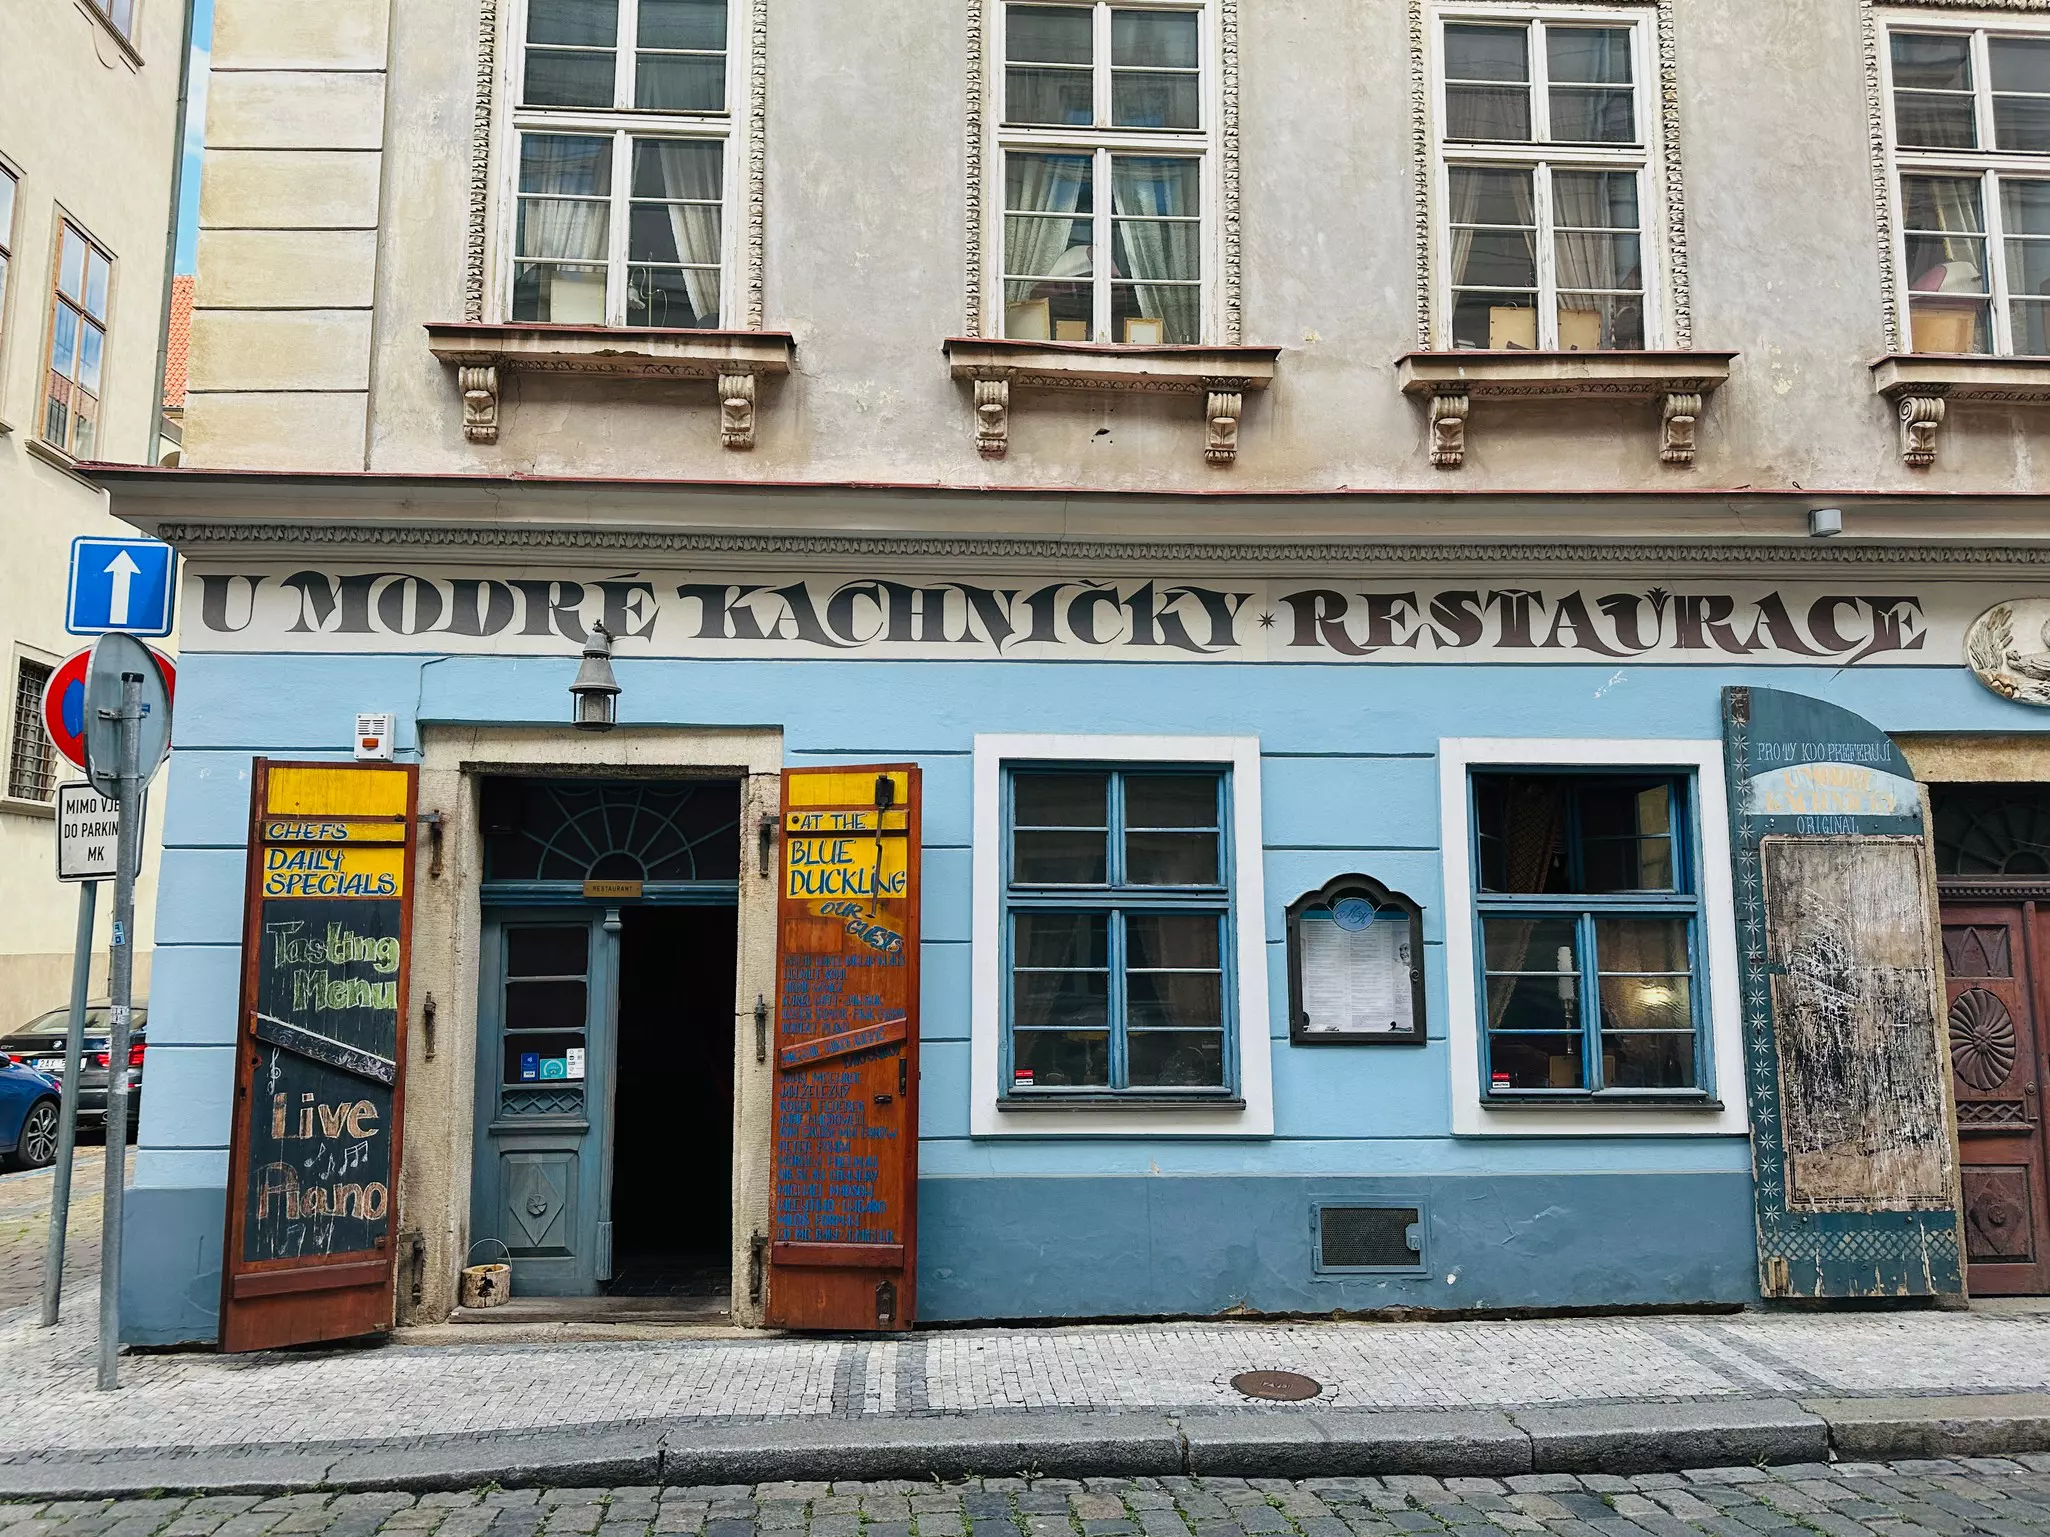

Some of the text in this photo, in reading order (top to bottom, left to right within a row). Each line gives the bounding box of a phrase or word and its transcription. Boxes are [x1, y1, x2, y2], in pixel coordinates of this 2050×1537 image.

[194, 574, 270, 632] U
[279, 569, 661, 644] MODRÉ
[1279, 586, 1928, 666] RESTAURACE
[1756, 742, 1780, 761] PRO
[1782, 742, 1797, 761] TY
[1801, 742, 1826, 761] KDO
[66, 798, 120, 814] MIMO VJE
[64, 820, 119, 838] DO PARKIN
[800, 813, 868, 830] AT THE
[87, 846, 105, 861] MK
[266, 848, 344, 872] DAILY
[790, 839, 856, 866] BLUE
[264, 872, 397, 896] SPECIALS
[592, 885, 633, 893] RESTAURANT
[789, 865, 906, 896] DUCKLING
[820, 901, 864, 919] OUR
[265, 920, 401, 974] Tasting
[845, 919, 904, 954] GUESTS
[292, 969, 398, 1012] Menu
[271, 1092, 380, 1139] Live
